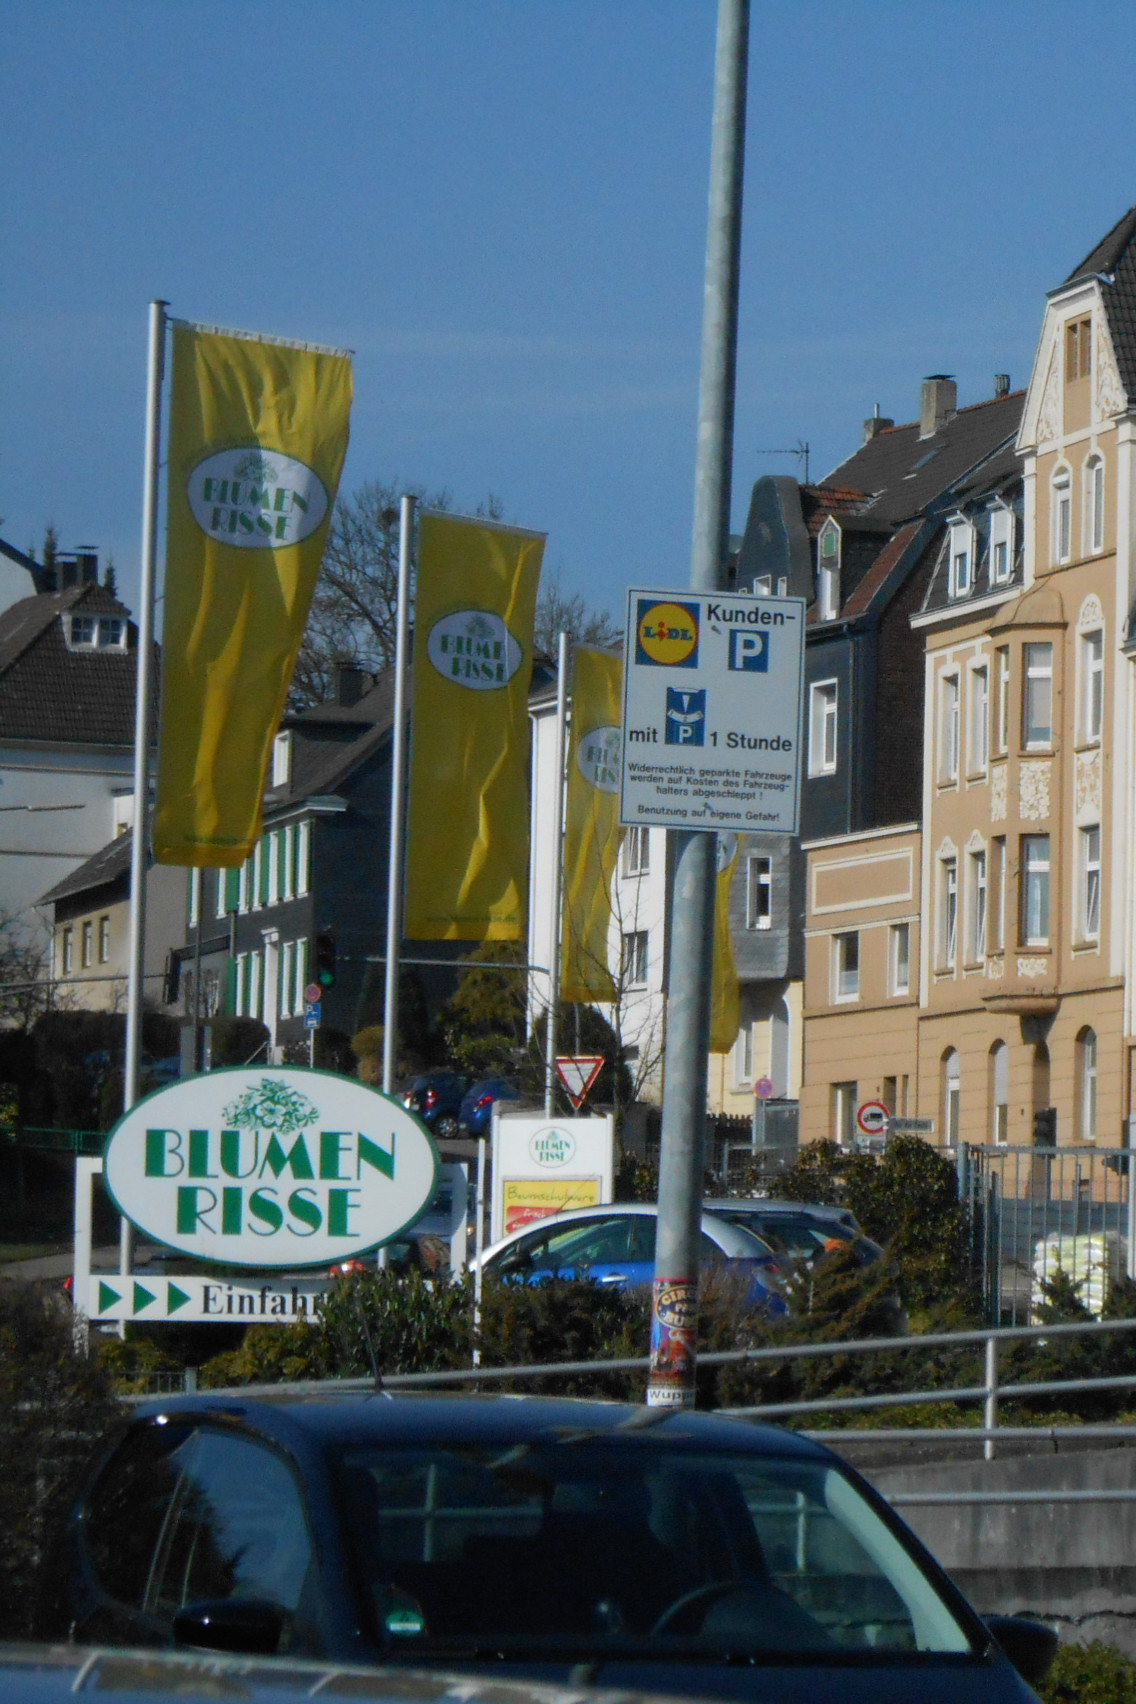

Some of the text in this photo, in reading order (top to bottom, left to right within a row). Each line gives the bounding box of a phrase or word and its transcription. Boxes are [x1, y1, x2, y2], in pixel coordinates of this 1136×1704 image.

[203, 477, 311, 514] BLUMEN
[210, 507, 292, 541] RISSE
[707, 604, 796, 626] Kunden-
[440, 634, 505, 660] BLUME
[735, 632, 763, 669] P
[451, 657, 507, 682] RISSE
[629, 725, 793, 752] mit P 1 Stunde
[628, 762, 792, 782] Widerrechtlich geparkte Fahrzeuge
[630, 773, 790, 791] werden auf Kosten des Fahrzeug-
[656, 785, 689, 797] halters
[692, 787, 756, 800] abgeschleppt
[638, 804, 780, 822] Benutzung auf eigene Gefahr!
[145, 1129, 396, 1181] BLUMEN
[535, 1140, 570, 1151] BLUMEN
[539, 1152, 565, 1162] RISSE
[176, 1186, 361, 1237] RISSE
[201, 1284, 325, 1316] Einfahr
